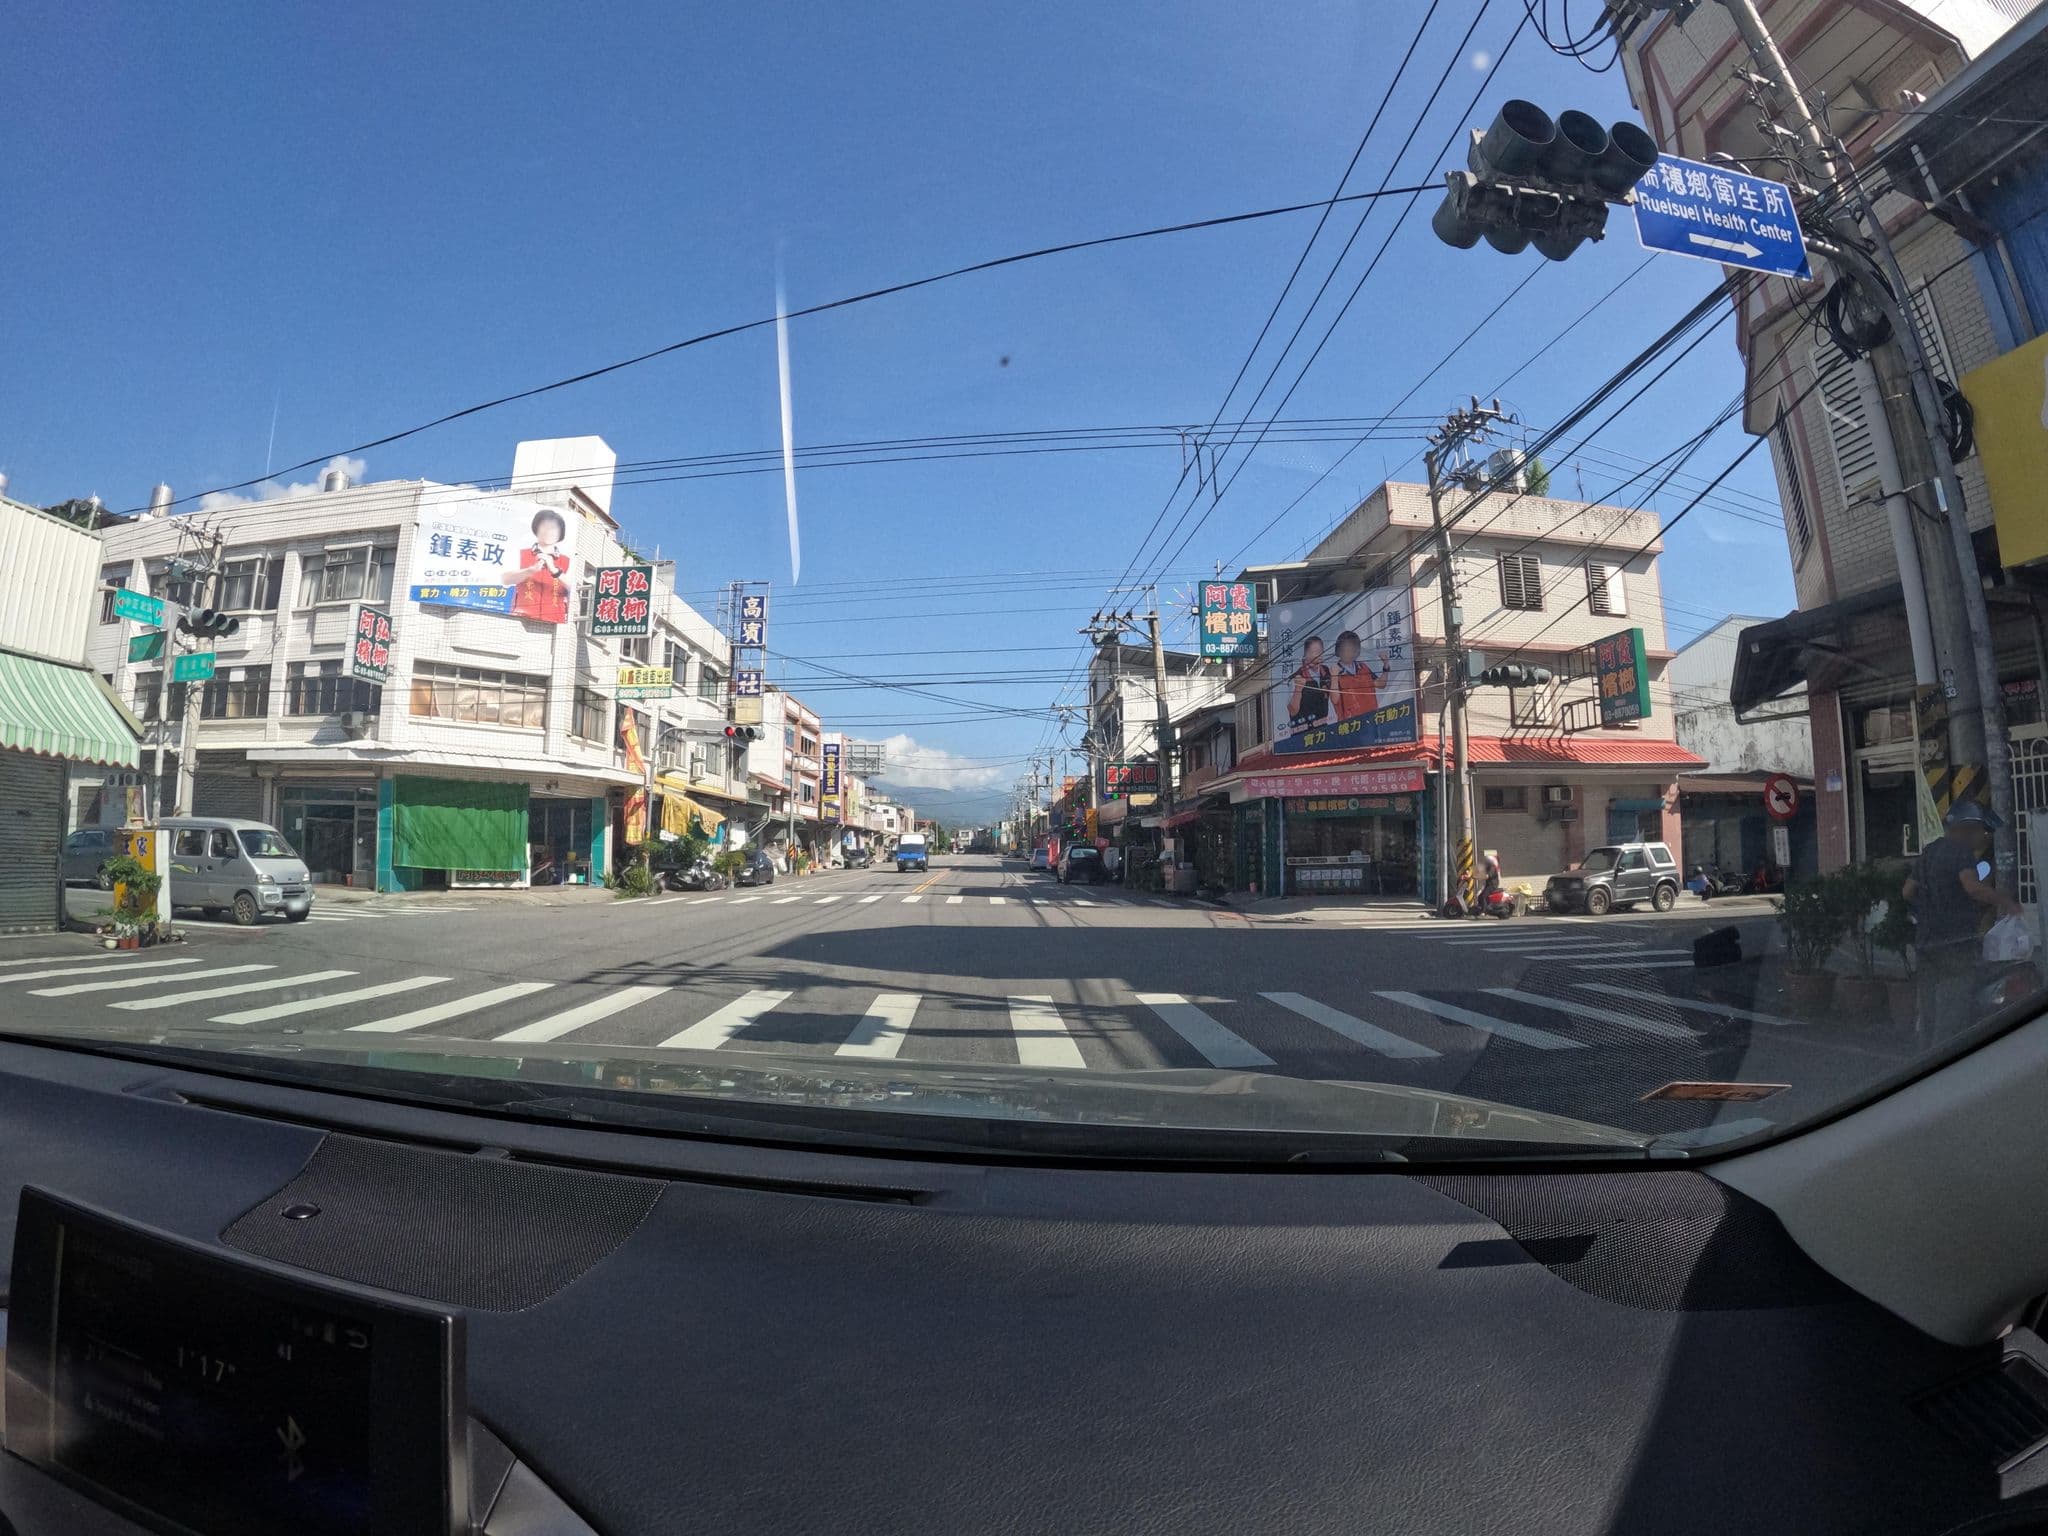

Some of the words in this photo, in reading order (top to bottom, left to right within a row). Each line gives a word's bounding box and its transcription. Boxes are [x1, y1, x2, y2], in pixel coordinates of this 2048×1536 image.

[1702, 206, 1748, 233] Health
[1750, 218, 1793, 244] Center
[599, 570, 649, 596] 阿弘
[595, 597, 648, 623] 檳榔
[1205, 584, 1252, 610] 阿霞
[359, 610, 390, 641] 阿弘
[1205, 611, 1252, 635] 檳榔
[356, 638, 388, 671] 檳榔
[1205, 643, 1254, 654] 03-8870059
[1599, 634, 1634, 669] 阿霞
[738, 673, 759, 694] 社
[1602, 667, 1636, 698] 檳榔
